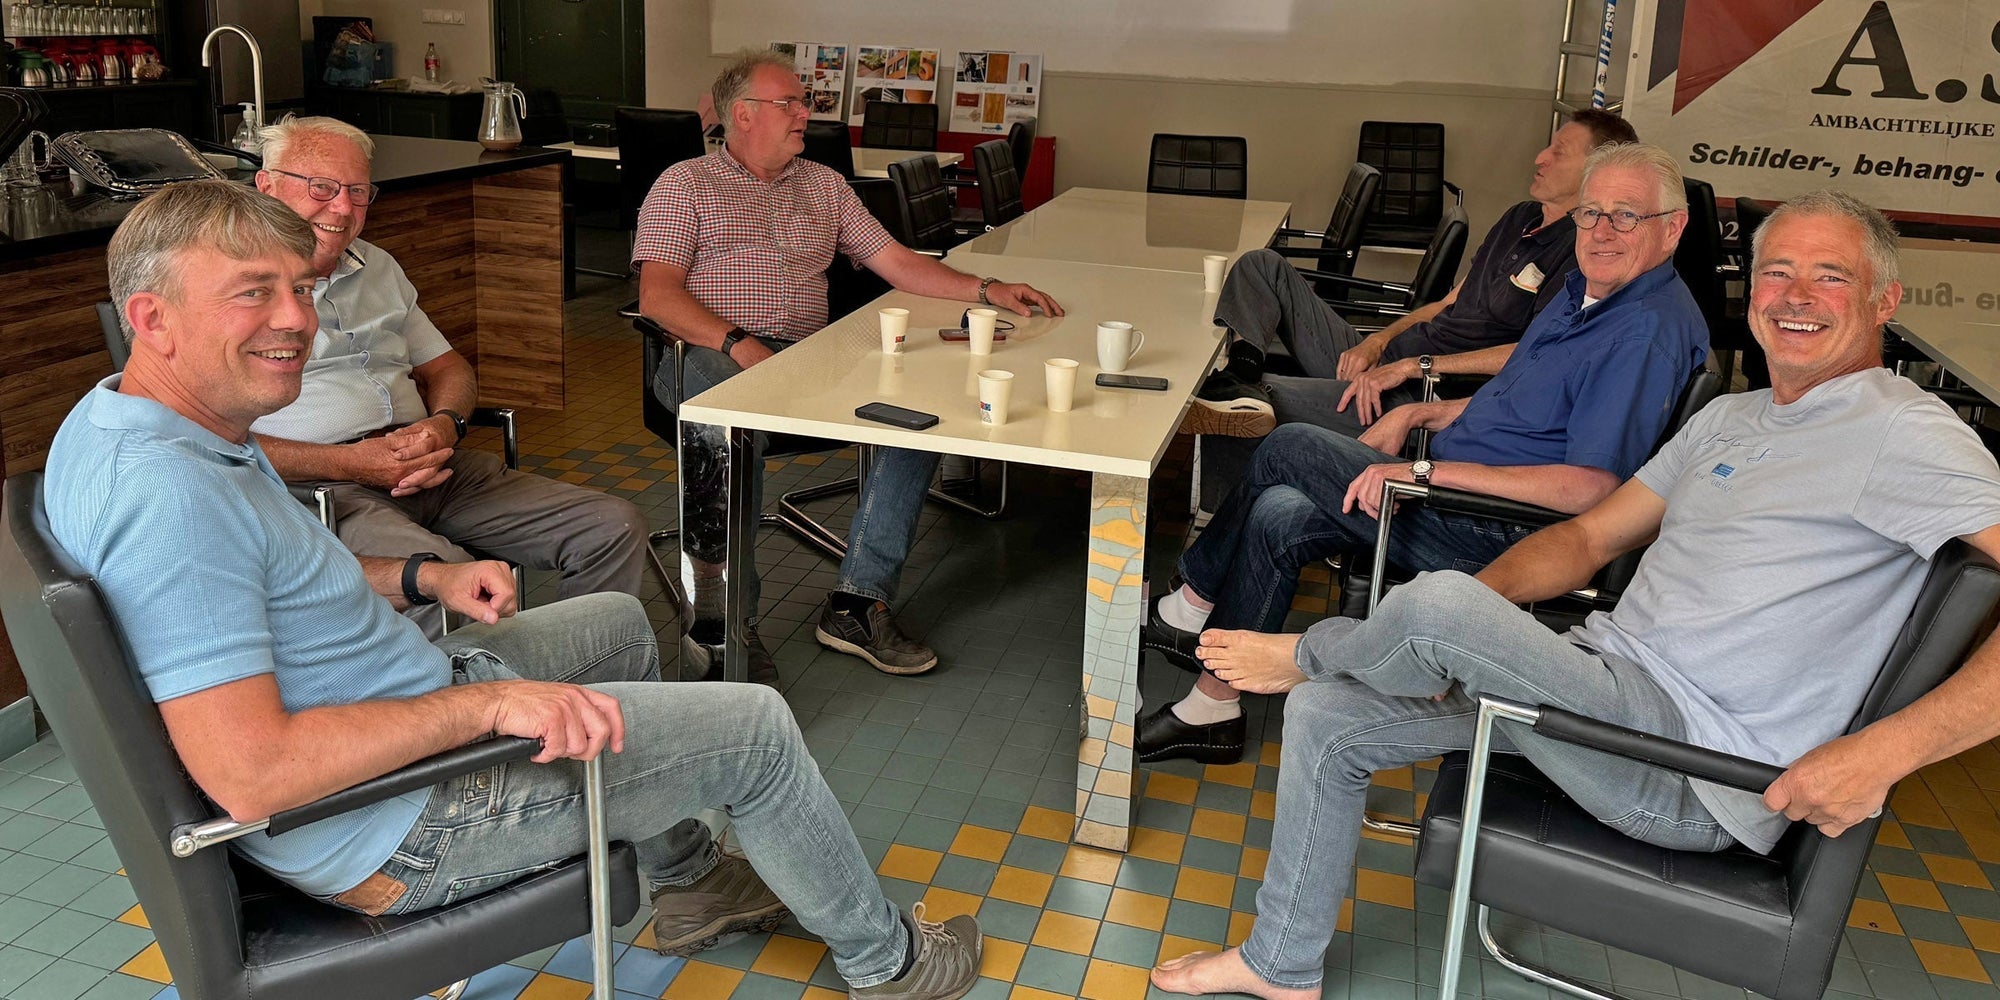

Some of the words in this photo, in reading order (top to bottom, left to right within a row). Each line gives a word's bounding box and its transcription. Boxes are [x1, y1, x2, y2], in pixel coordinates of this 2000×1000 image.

[1809, 113, 1995, 138] AMBACHTELIJKE
[1689, 142, 1841, 178] Schilder-,
[1853, 154, 1985, 187] behang-
[1718, 221, 1740, 241] 2
